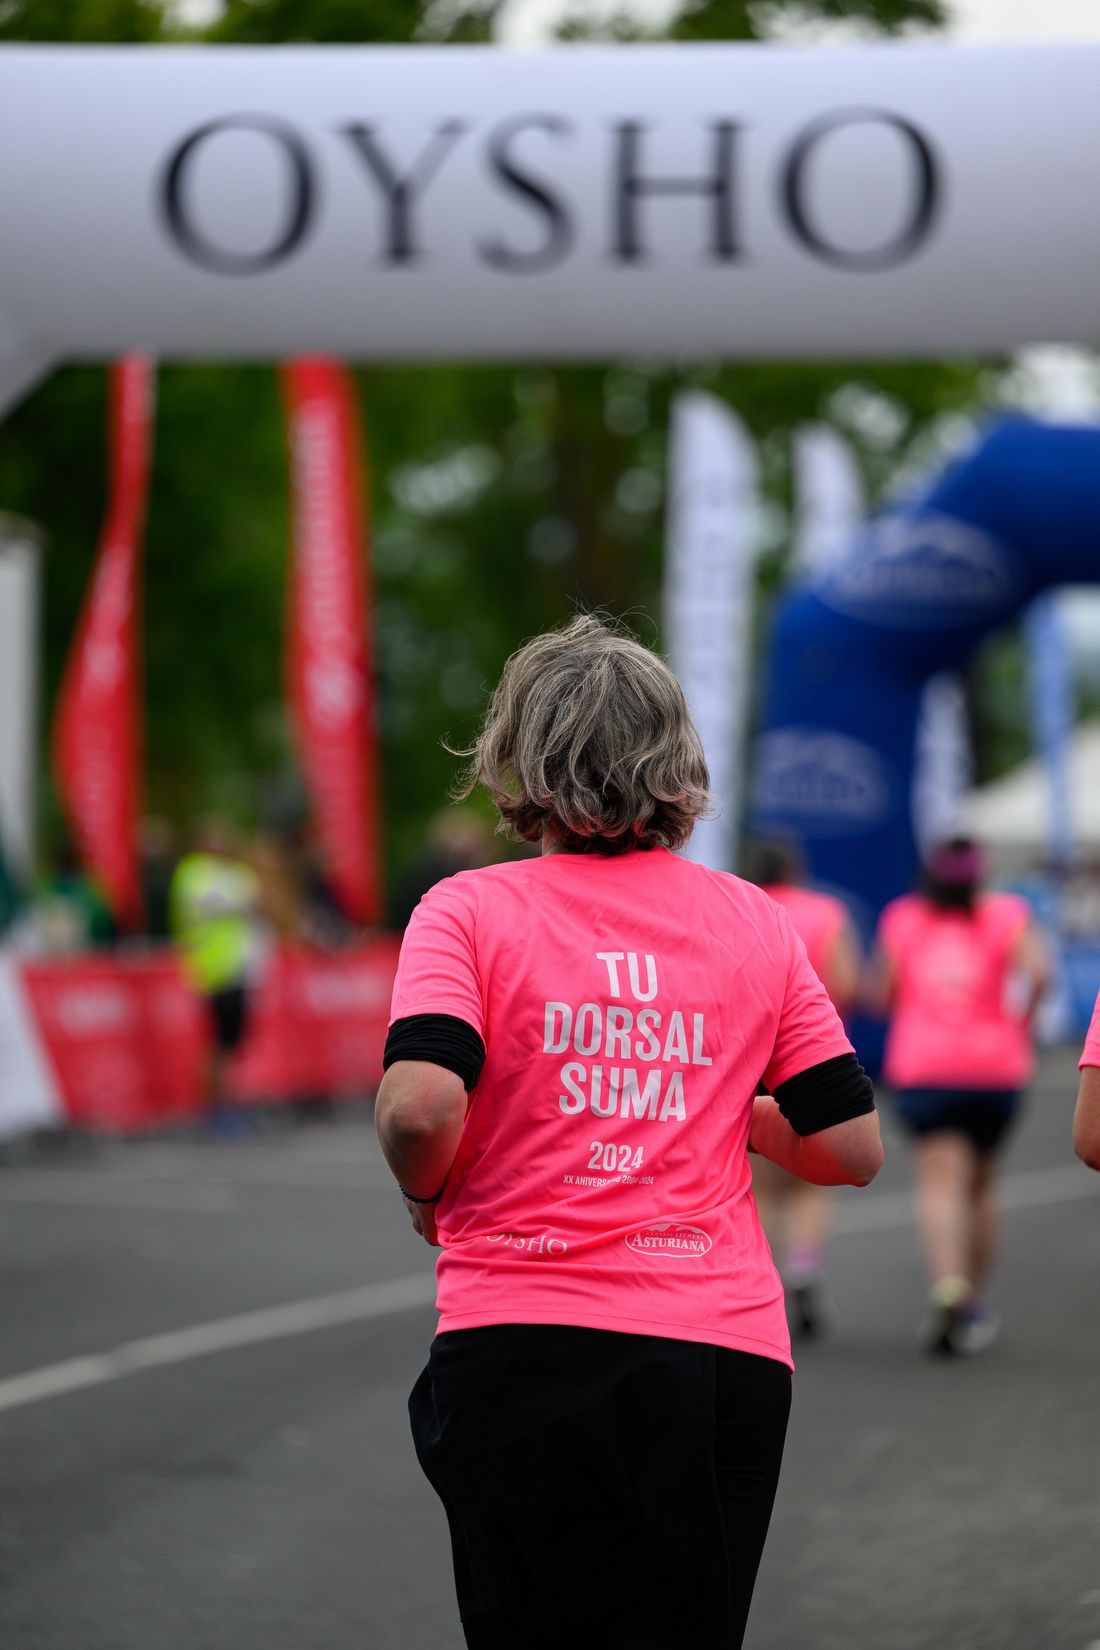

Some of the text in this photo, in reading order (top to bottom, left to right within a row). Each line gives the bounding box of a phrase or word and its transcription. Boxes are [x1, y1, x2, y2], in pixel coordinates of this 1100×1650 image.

[155, 107, 948, 276] OYSHO
[596, 952, 658, 1002] TU
[543, 1001, 713, 1066] DORSAL
[559, 1062, 687, 1122] SUMA
[563, 1174, 574, 1185] XX
[588, 1141, 644, 1172] 2024
[631, 1232, 706, 1252] ASTURIANA
